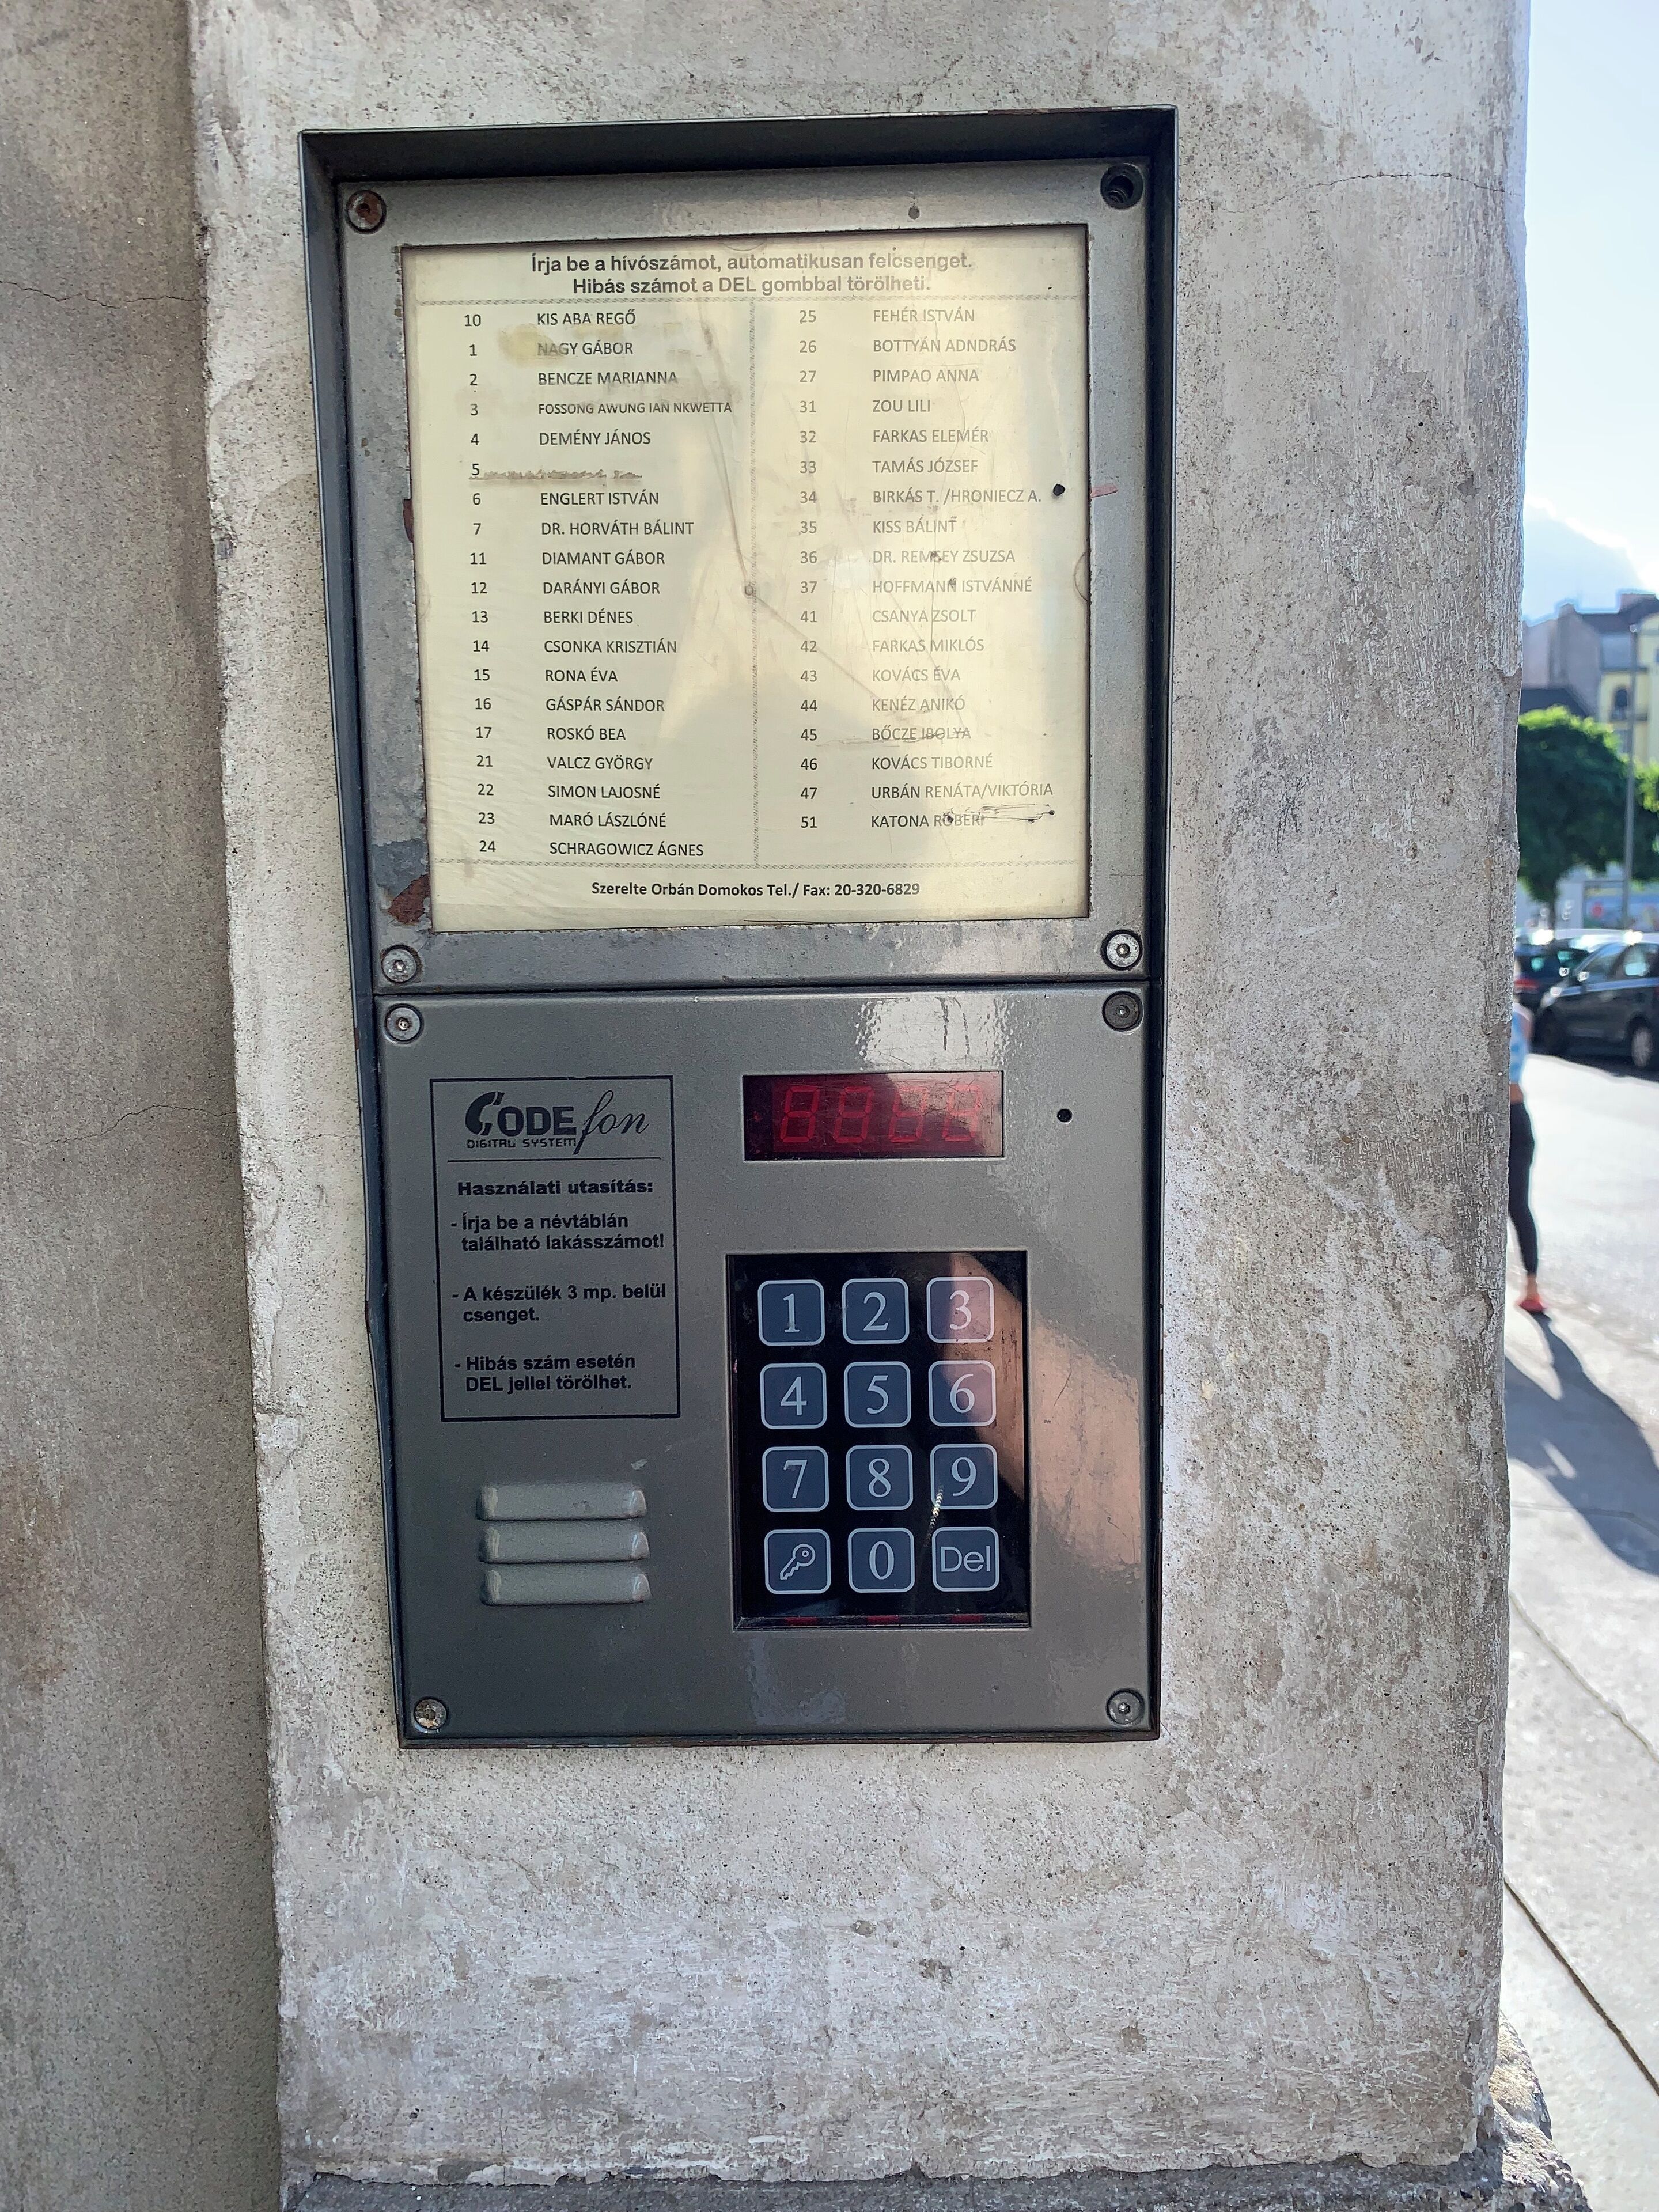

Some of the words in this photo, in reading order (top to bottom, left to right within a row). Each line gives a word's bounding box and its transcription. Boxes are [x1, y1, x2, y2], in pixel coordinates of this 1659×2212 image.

[532, 253, 561, 275] Írja
[567, 256, 589, 271] be
[595, 260, 605, 271] a
[611, 255, 721, 272] hívószámot,
[728, 254, 863, 270] automatikusan
[869, 253, 972, 272] felcsenget.
[574, 279, 625, 293] Hibás
[631, 278, 698, 293] számot
[702, 281, 713, 292] a
[719, 276, 756, 292] DEL
[762, 276, 841, 296] gombbal
[847, 276, 930, 291] törölheti.
[465, 314, 481, 326] 10
[537, 313, 558, 325] KIS
[563, 313, 591, 324] ABA
[597, 309, 635, 324] REGŐ
[800, 310, 816, 324] 25
[874, 305, 918, 322] FEHÉR
[470, 344, 477, 356] 1
[538, 343, 578, 355] NAGY
[582, 340, 632, 355] GÁBOR
[800, 340, 816, 353] 26
[945, 336, 1016, 352] ADNDRÁS
[470, 374, 477, 385] 2
[539, 373, 592, 385] BENCZE
[598, 372, 676, 384] MARIANNA
[800, 370, 816, 382] 27
[874, 370, 931, 382] PIMPAO
[471, 404, 478, 415] 3
[539, 404, 593, 414] FOSSONG
[598, 403, 645, 414] AWUNG
[650, 403, 669, 413] IAN
[674, 402, 732, 412] NKWETTA
[800, 401, 816, 412] 31
[873, 400, 902, 412] ZOU
[908, 400, 930, 412] LILI
[471, 434, 479, 445] 4
[540, 429, 601, 445] DEMÉNY
[605, 429, 650, 445] JÁNOS
[800, 430, 816, 443] 32
[873, 430, 927, 442] FARKAS
[933, 426, 988, 443] ELEMÉR
[472, 464, 479, 475] 5
[800, 461, 816, 474] 33
[872, 457, 923, 473] TAMÁS
[927, 457, 978, 472] JÓZSEF
[473, 493, 480, 505] 6
[541, 493, 604, 505] ENGLERT
[609, 489, 658, 505] ISTVÁN
[800, 491, 817, 503] 34
[873, 487, 922, 503] BIRKÁS
[927, 490, 938, 502] T.
[1028, 490, 1041, 502] A.
[474, 523, 481, 535] 7
[542, 522, 564, 535] DR.
[570, 520, 638, 535] HORVÁTH
[644, 519, 694, 535] BÁLINT
[799, 521, 817, 535] 35
[874, 521, 901, 533] KISS
[471, 553, 486, 565] 11
[543, 552, 611, 565] DIAMANT
[615, 549, 665, 565] GÁBOR
[801, 551, 817, 563] 36
[472, 582, 487, 593] 12
[544, 579, 605, 594] DARÁNYI
[610, 579, 660, 594] GÁBOR
[801, 581, 817, 593] 37
[472, 611, 488, 623] 13
[544, 611, 582, 623] BERKI
[588, 608, 632, 623] DÉNES
[801, 611, 817, 622] 41
[474, 640, 489, 652] 14
[544, 641, 602, 653] CSONKA
[607, 638, 676, 653] KRISZTIÁN
[801, 641, 817, 652] 42
[475, 669, 490, 681] 15
[546, 670, 586, 681] RONA
[591, 667, 618, 681] ÉVA
[801, 670, 817, 682] 43
[475, 698, 491, 710] 16
[546, 696, 601, 711] GÁSPÁR
[606, 696, 664, 711] SÁNDOR
[801, 700, 817, 711] 44
[476, 727, 491, 738] 17
[548, 725, 594, 740] ROSKÓ
[600, 728, 626, 740] BEA
[801, 729, 817, 741] 45
[873, 725, 916, 742] BŐCZE
[477, 755, 493, 767] 21
[547, 757, 591, 769] VALCZ
[595, 755, 653, 770] GYÖRGY
[801, 758, 817, 770] 46
[873, 754, 927, 769] KOVÁCS
[931, 753, 992, 768] TIBORNÉ
[478, 784, 494, 796] 22
[548, 785, 596, 798] SIMON
[601, 784, 660, 798] LAJOSNÉ
[801, 787, 817, 799] 47
[872, 783, 919, 798] URBÁN
[926, 781, 1053, 799] RENÁTA/VIKTÓRIA
[479, 812, 494, 824] 23
[550, 812, 593, 826] MARÓ
[599, 812, 666, 827] LÁSZLÓNÉ
[801, 816, 817, 828] 51
[872, 815, 929, 827] KATONA
[480, 840, 496, 852] 24
[550, 842, 653, 855] SCHRAGOWICZ
[657, 841, 703, 856] ÁGNES
[592, 882, 647, 895] Szerelte
[652, 883, 693, 895] Orbán
[699, 884, 763, 896] Domokos
[767, 883, 799, 898] Tel./
[804, 885, 830, 896] Fax:
[835, 884, 919, 895] 20-320-6829
[467, 1139, 516, 1149] DIGITAL
[522, 1138, 578, 1150] SYSTEM
[458, 1180, 560, 1195] Használati
[567, 1179, 653, 1194] utasítás:
[463, 1212, 491, 1233] Írja
[497, 1215, 518, 1229] be
[524, 1218, 534, 1229] a
[540, 1213, 628, 1229] névtáblán
[462, 1235, 540, 1251] található
[546, 1233, 664, 1249] lakásszámot!
[463, 1286, 478, 1301] A
[483, 1285, 561, 1301] készülék
[567, 1285, 577, 1299] 3
[584, 1287, 616, 1302] mp.
[623, 1283, 666, 1298] belül
[464, 1306, 539, 1325] csenget.
[783, 1294, 800, 1332] 1
[863, 1292, 888, 1331] 2
[950, 1290, 971, 1332] 3
[467, 1355, 517, 1371] Hibás
[523, 1355, 570, 1370] szám
[576, 1353, 635, 1370] esetén
[467, 1377, 503, 1391] DEL
[507, 1374, 550, 1395] jellel
[556, 1372, 631, 1390] törölhet.
[781, 1377, 806, 1415] 4
[867, 1375, 888, 1414] 5
[950, 1374, 975, 1413] 6
[783, 1460, 807, 1498] 7
[869, 1459, 891, 1497] 8
[952, 1457, 976, 1496] 9
[869, 1541, 894, 1580] 0
[941, 1546, 990, 1572] Del
